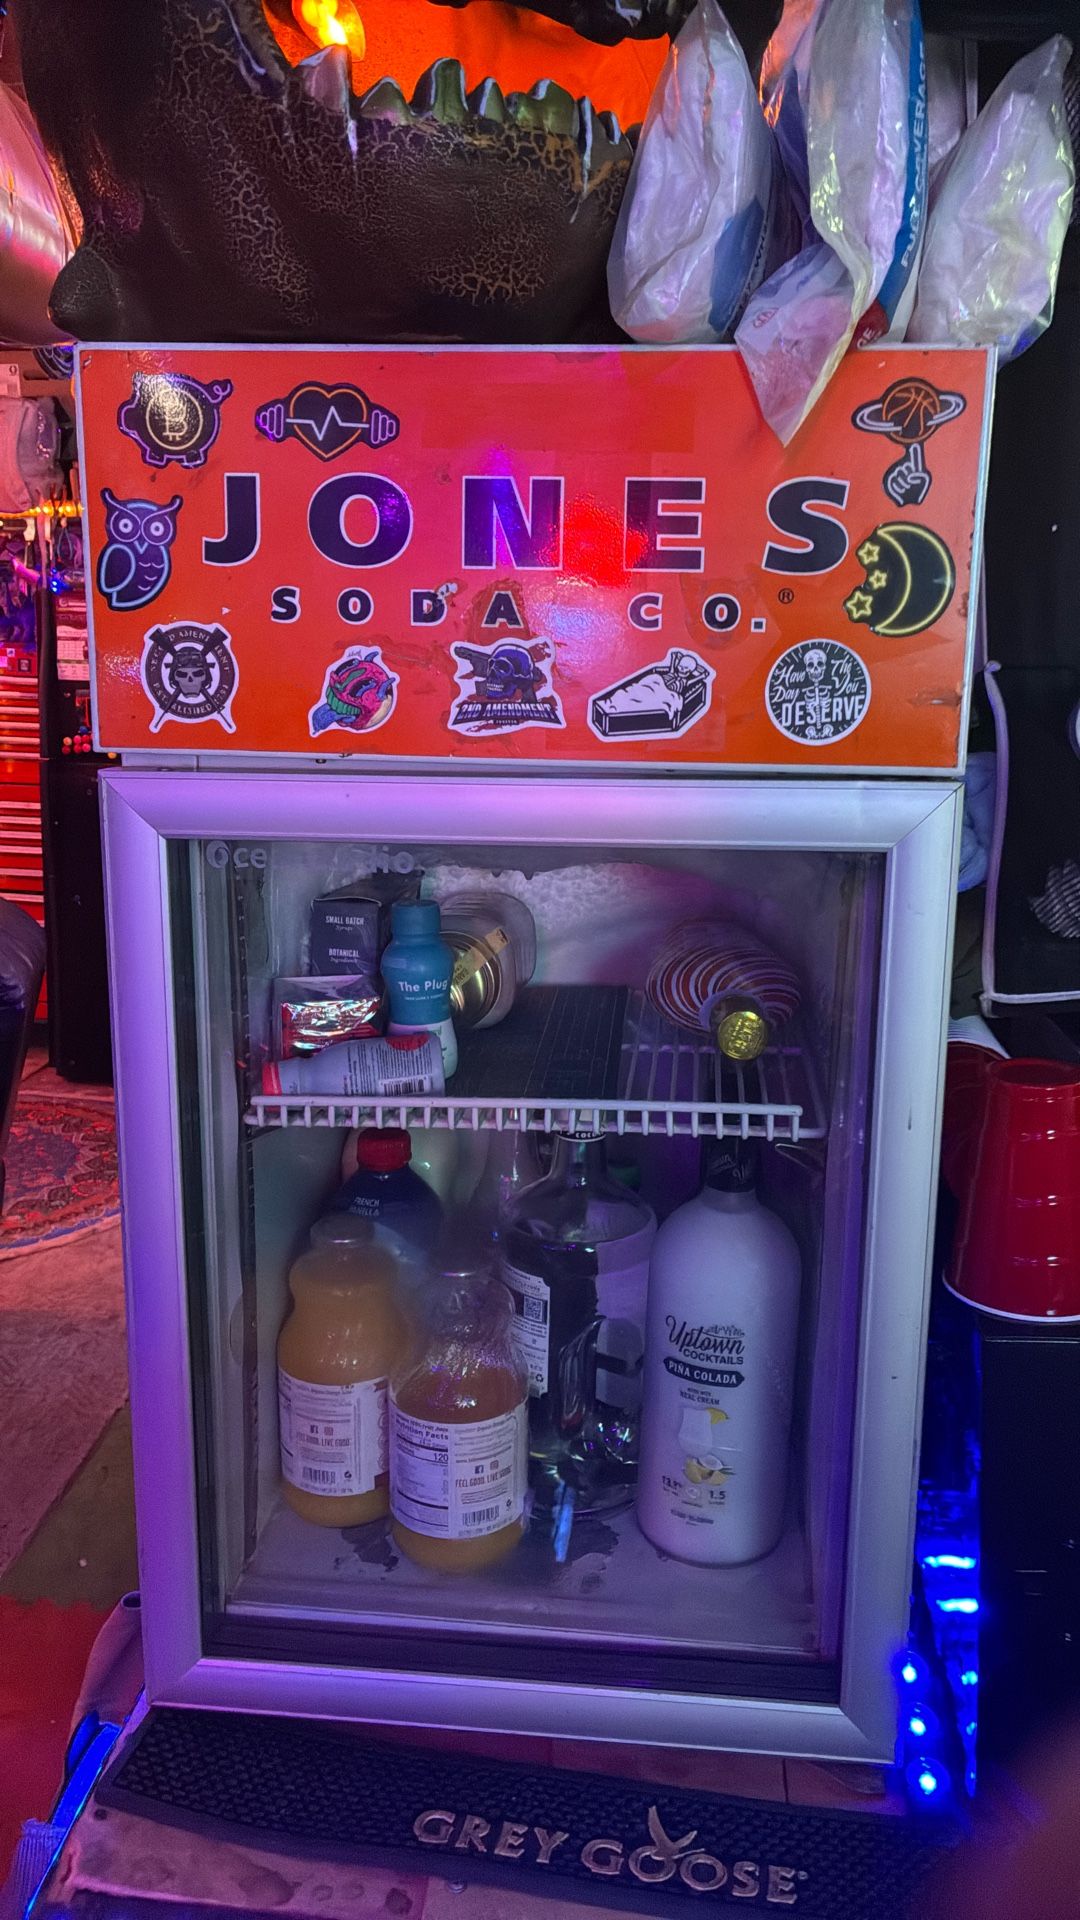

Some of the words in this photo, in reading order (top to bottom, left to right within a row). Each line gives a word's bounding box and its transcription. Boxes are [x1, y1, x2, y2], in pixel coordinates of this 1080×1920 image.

[202, 472, 851, 576] JONES
[271, 585, 525, 628] SODA
[628, 593, 767, 633] CO.
[773, 664, 806, 688] Have
[831, 654, 853, 677] The
[771, 685, 800, 706] Day
[831, 674, 860, 697] You
[456, 702, 482, 720] 2ND
[482, 702, 556, 720] AMENDMENT
[781, 694, 866, 727] DESERVE
[325, 915, 344, 924] SMALL
[345, 916, 365, 926] BATCH
[328, 948, 360, 957] BOTANICAL
[398, 981, 420, 993] The
[424, 978, 448, 994] Plug
[352, 1196, 380, 1207] FRENCH
[665, 1315, 745, 1356] Uptown
[682, 1348, 744, 1366] COCKTAILS
[667, 1359, 691, 1378] PIÑA
[693, 1369, 738, 1385] COLADA
[696, 1394, 720, 1406] CREAM
[426, 1430, 448, 1440] Facts
[433, 1453, 449, 1463] 120
[455, 1478, 468, 1489] FEEL
[487, 1471, 498, 1484] LIVE
[709, 1489, 727, 1500] 1.5
[413, 1808, 570, 1864] GREY
[580, 1838, 798, 1904] GOOSE
